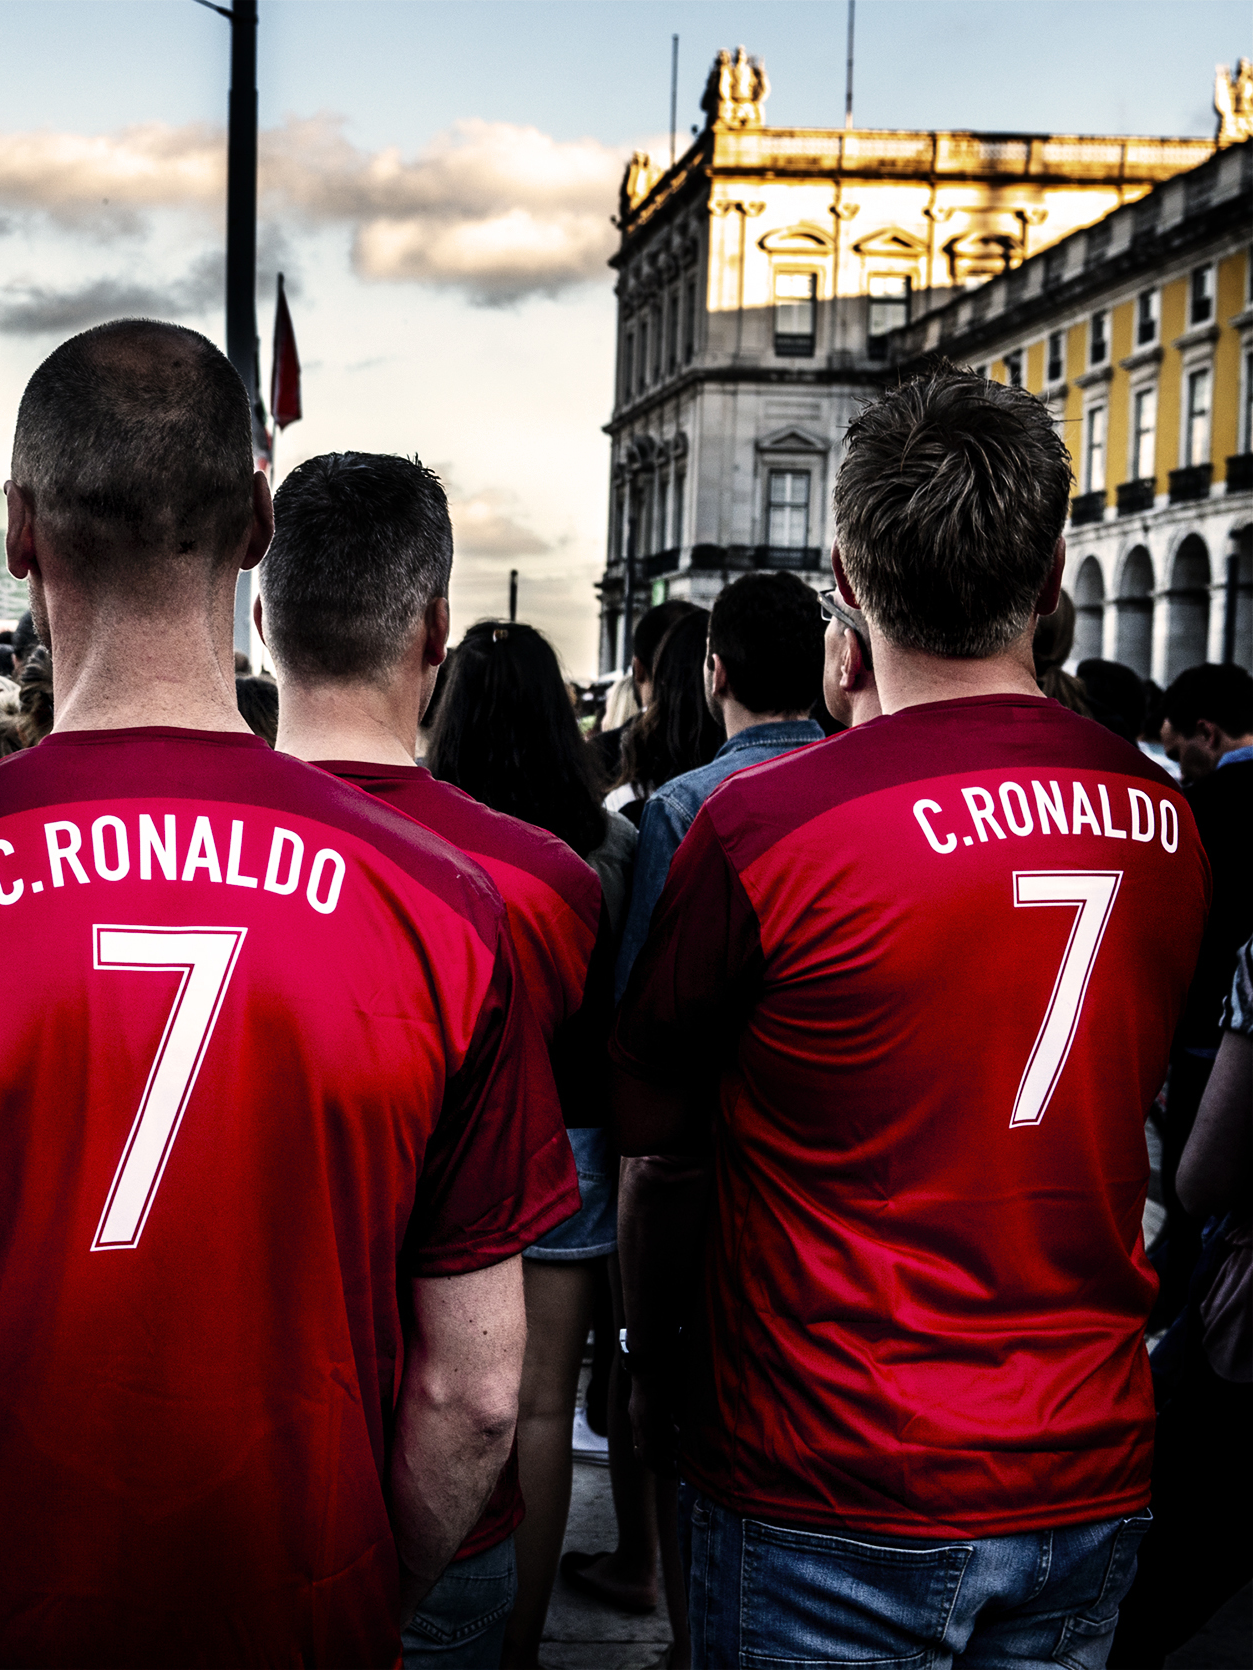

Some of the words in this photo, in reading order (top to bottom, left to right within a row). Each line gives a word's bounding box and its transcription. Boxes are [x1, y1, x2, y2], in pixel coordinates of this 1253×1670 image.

[912, 780, 1179, 855] C.RONALDO
[89, 923, 249, 1252] 7
[1008, 869, 1124, 1129] 7
